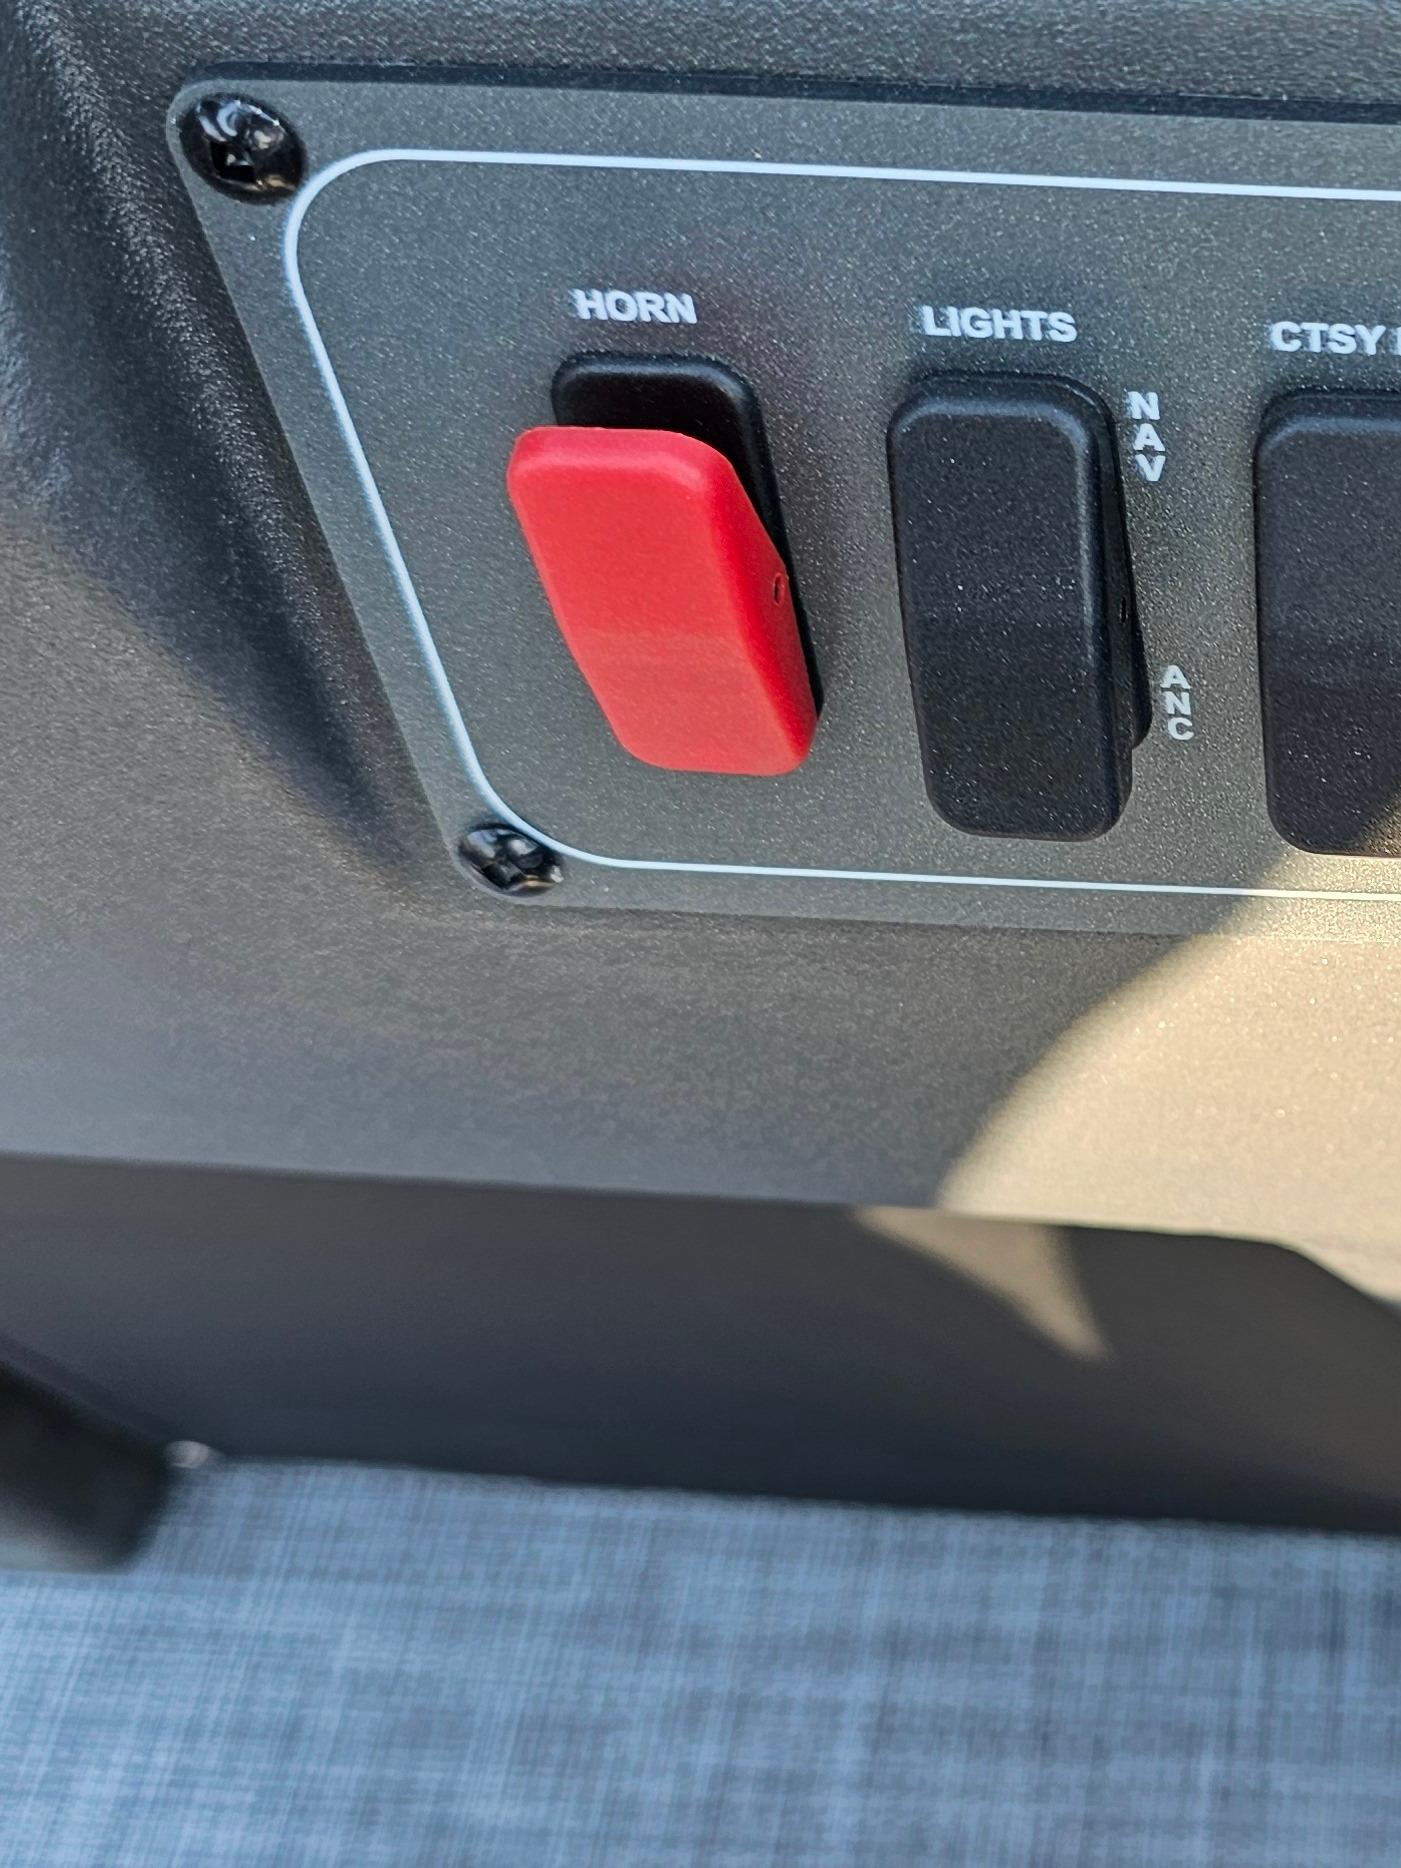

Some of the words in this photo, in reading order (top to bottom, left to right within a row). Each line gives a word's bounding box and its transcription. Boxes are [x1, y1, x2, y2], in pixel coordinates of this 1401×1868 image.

[571, 289, 698, 325] HORN
[919, 304, 1078, 343] LIGHTS
[1268, 320, 1386, 356] CTSY
[1126, 391, 1166, 483] NAV
[1160, 664, 1194, 741] ANC
